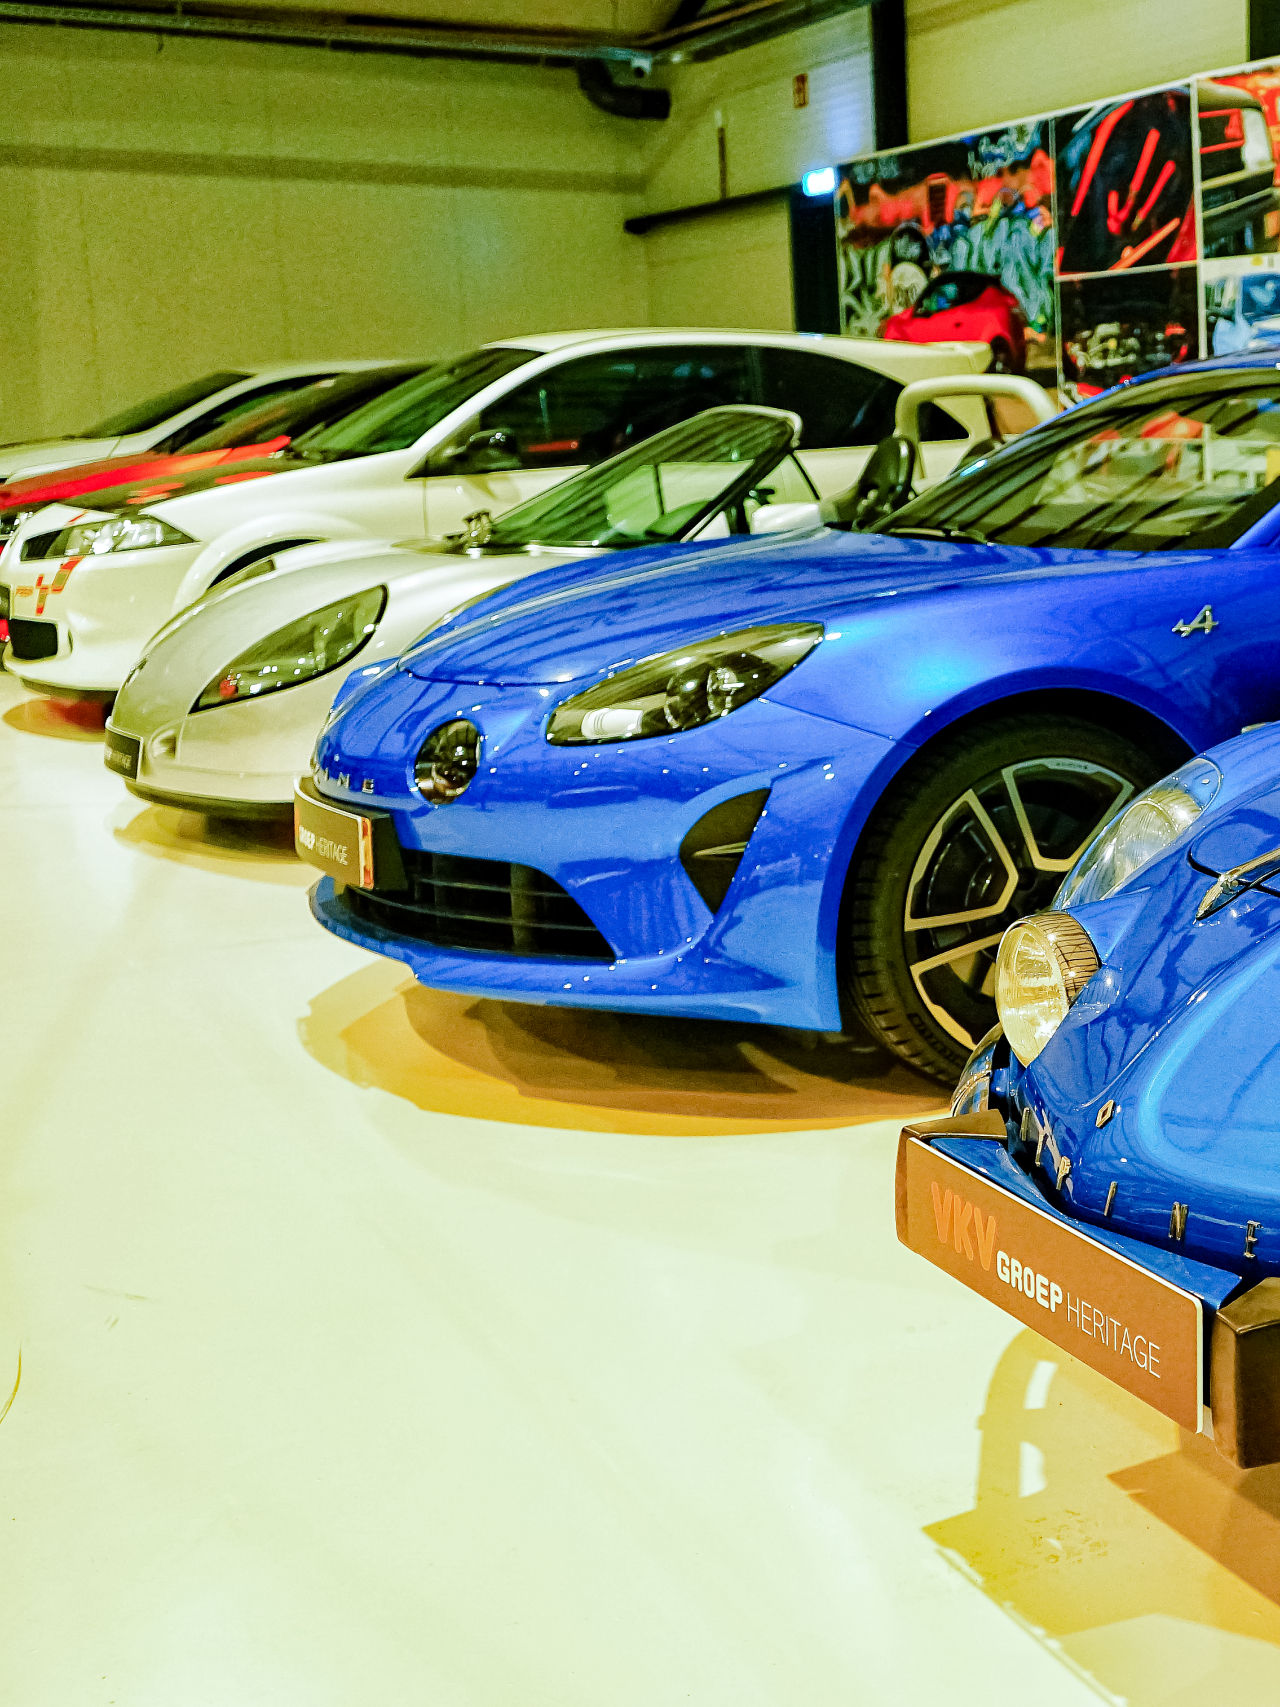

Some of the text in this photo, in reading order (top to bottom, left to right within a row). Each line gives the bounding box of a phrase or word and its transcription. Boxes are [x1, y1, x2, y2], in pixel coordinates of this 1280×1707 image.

[931, 1181, 1161, 1378] VKV GROEP HERITAGE
